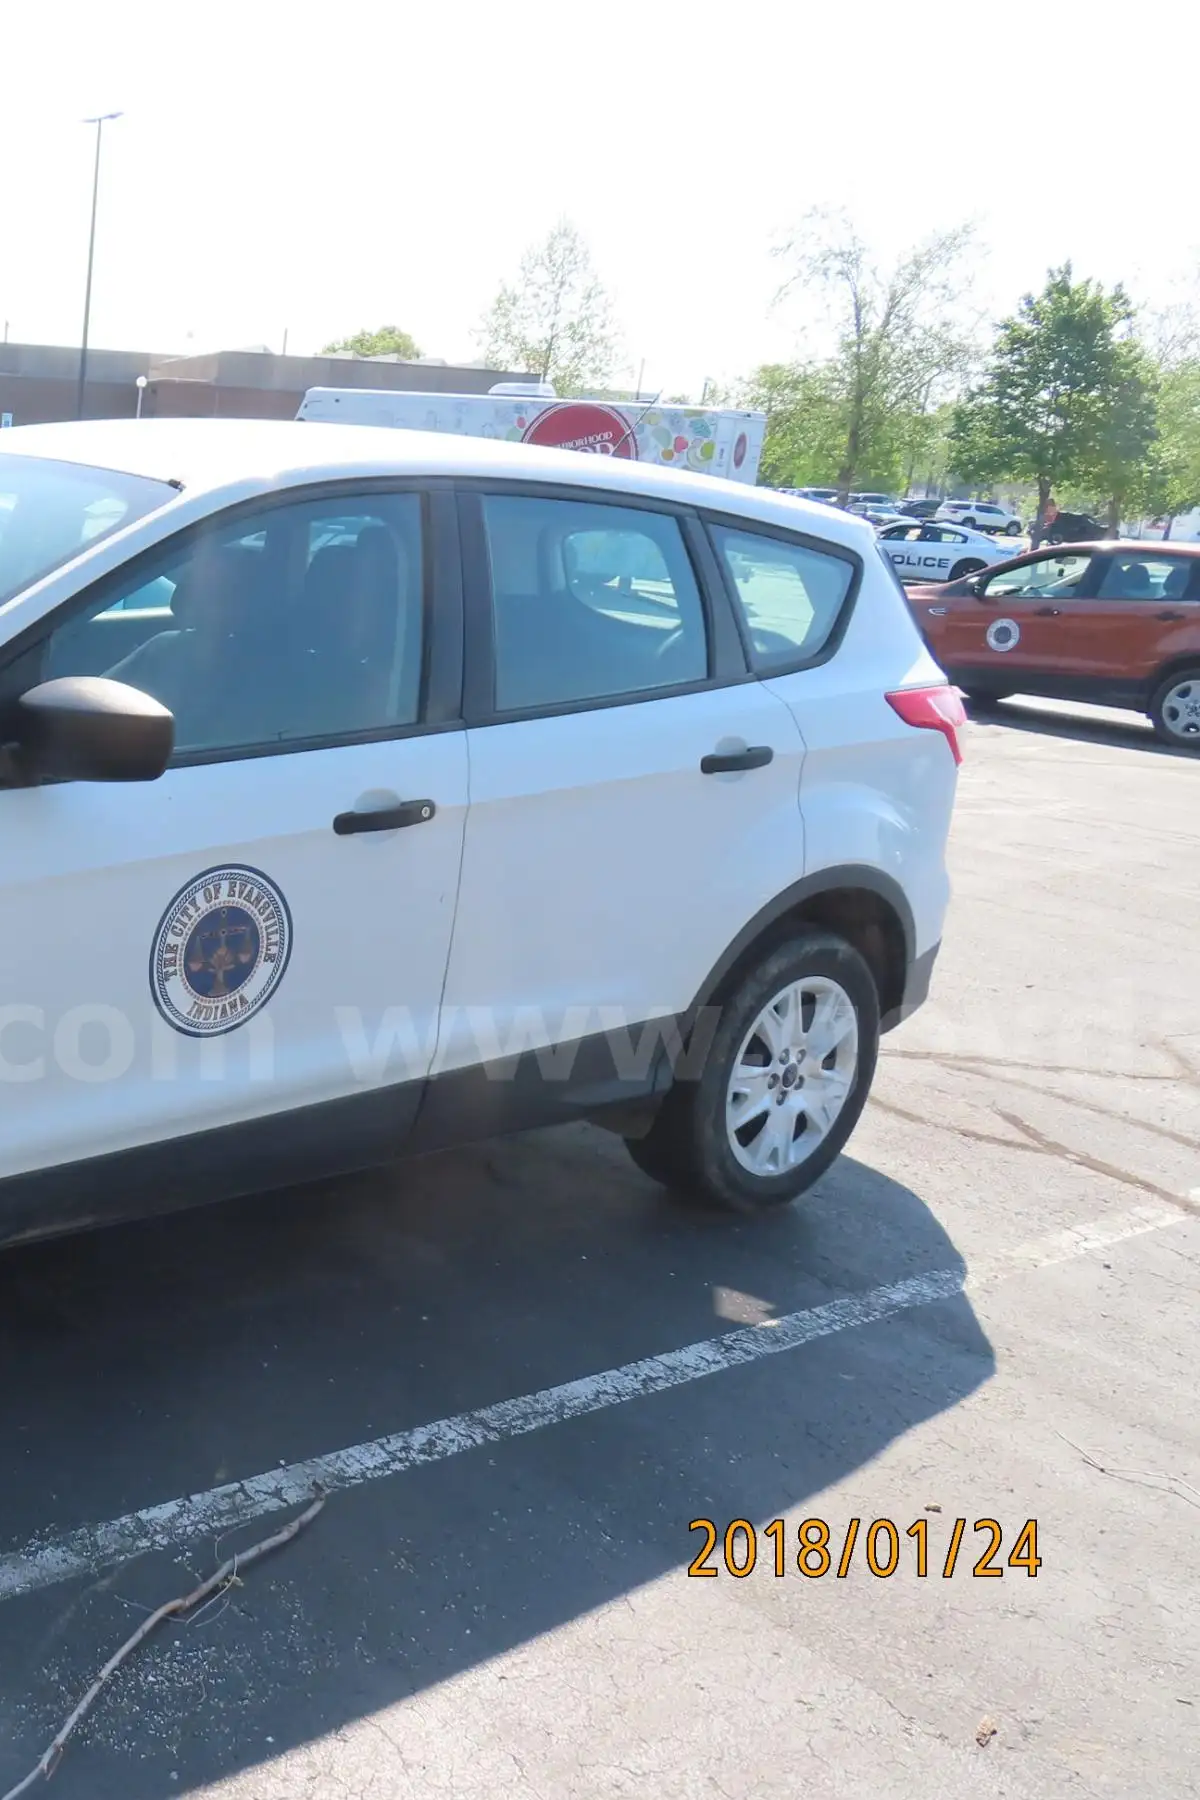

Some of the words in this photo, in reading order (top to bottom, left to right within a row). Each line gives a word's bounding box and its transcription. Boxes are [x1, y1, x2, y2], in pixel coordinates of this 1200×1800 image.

[890, 554, 950, 568] OLICE
[163, 943, 179, 982] THE
[171, 897, 202, 938] CITY
[203, 882, 222, 904] OF
[227, 880, 280, 963] EVANSVILLE
[186, 994, 250, 1021] INDIANA
